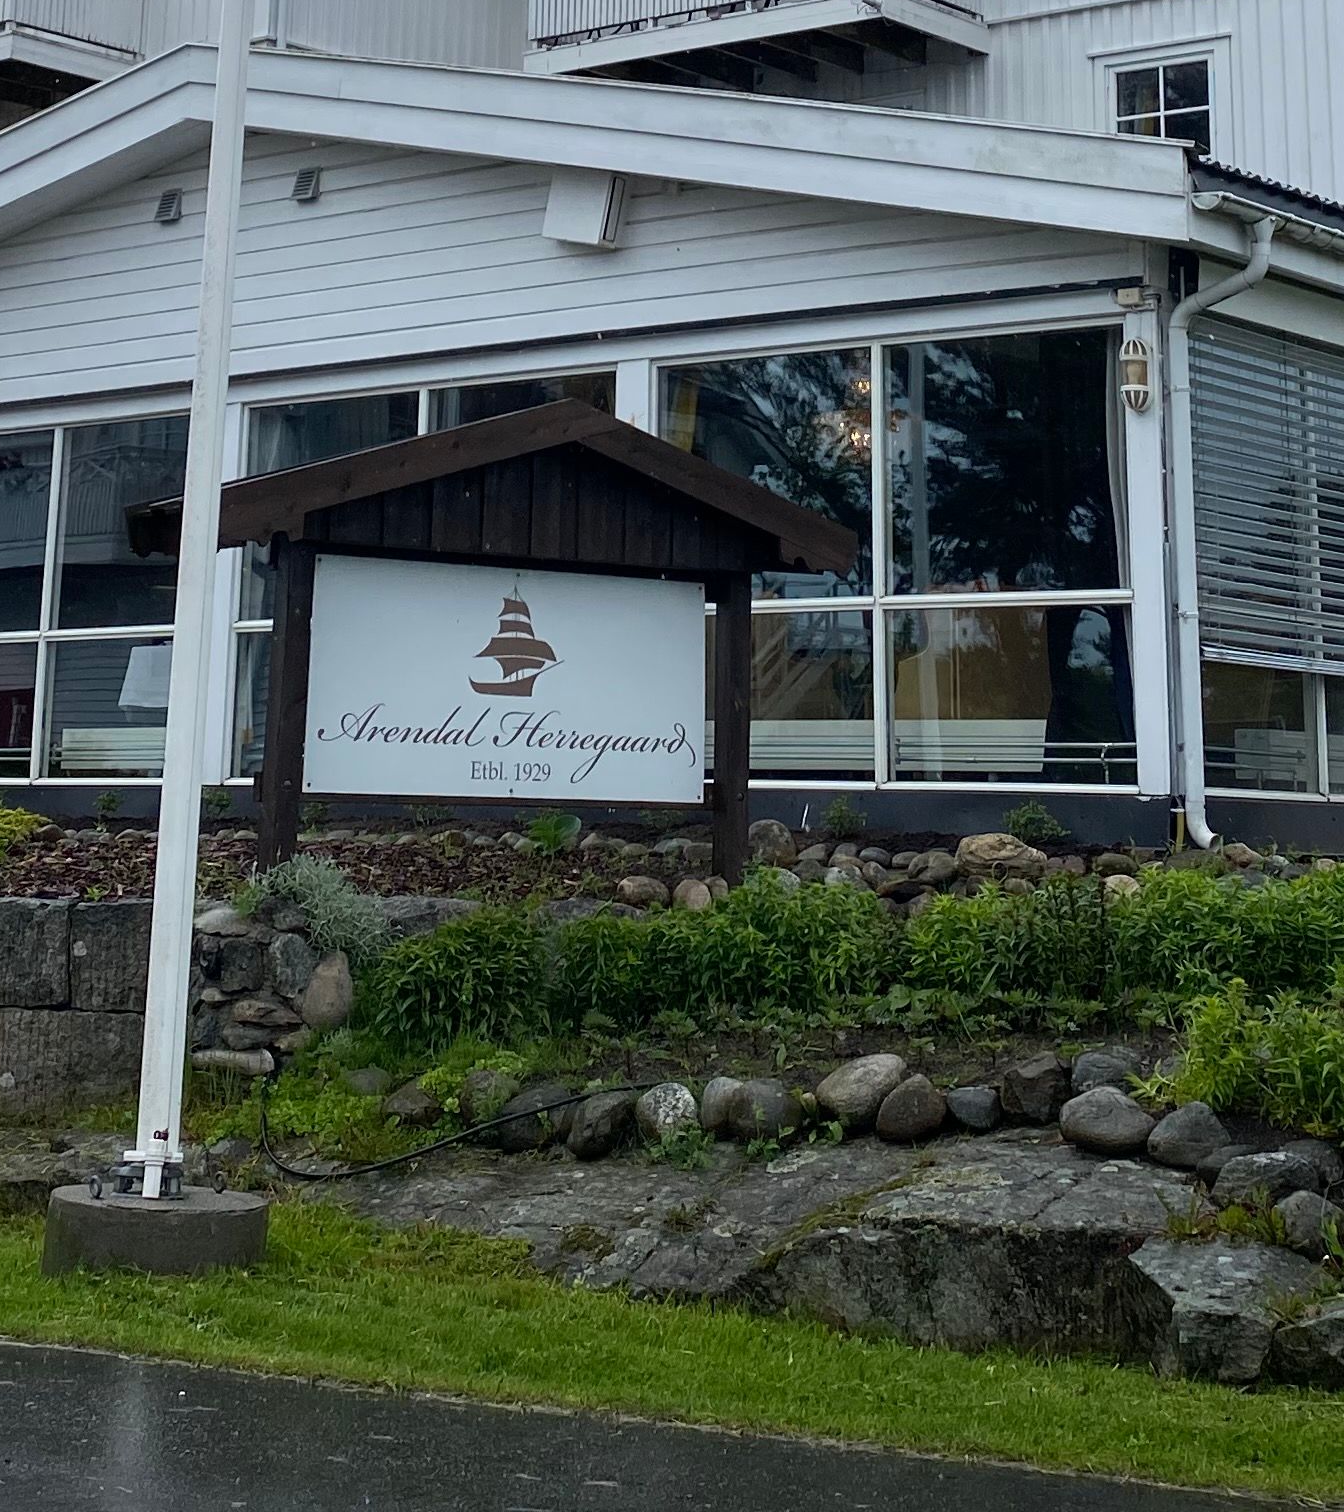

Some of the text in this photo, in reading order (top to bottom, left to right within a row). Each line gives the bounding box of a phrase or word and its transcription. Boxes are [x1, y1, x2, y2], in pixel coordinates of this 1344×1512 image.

[317, 702, 697, 785] Arendal Herregaard
[470, 760, 552, 783] Etbl. 1929
